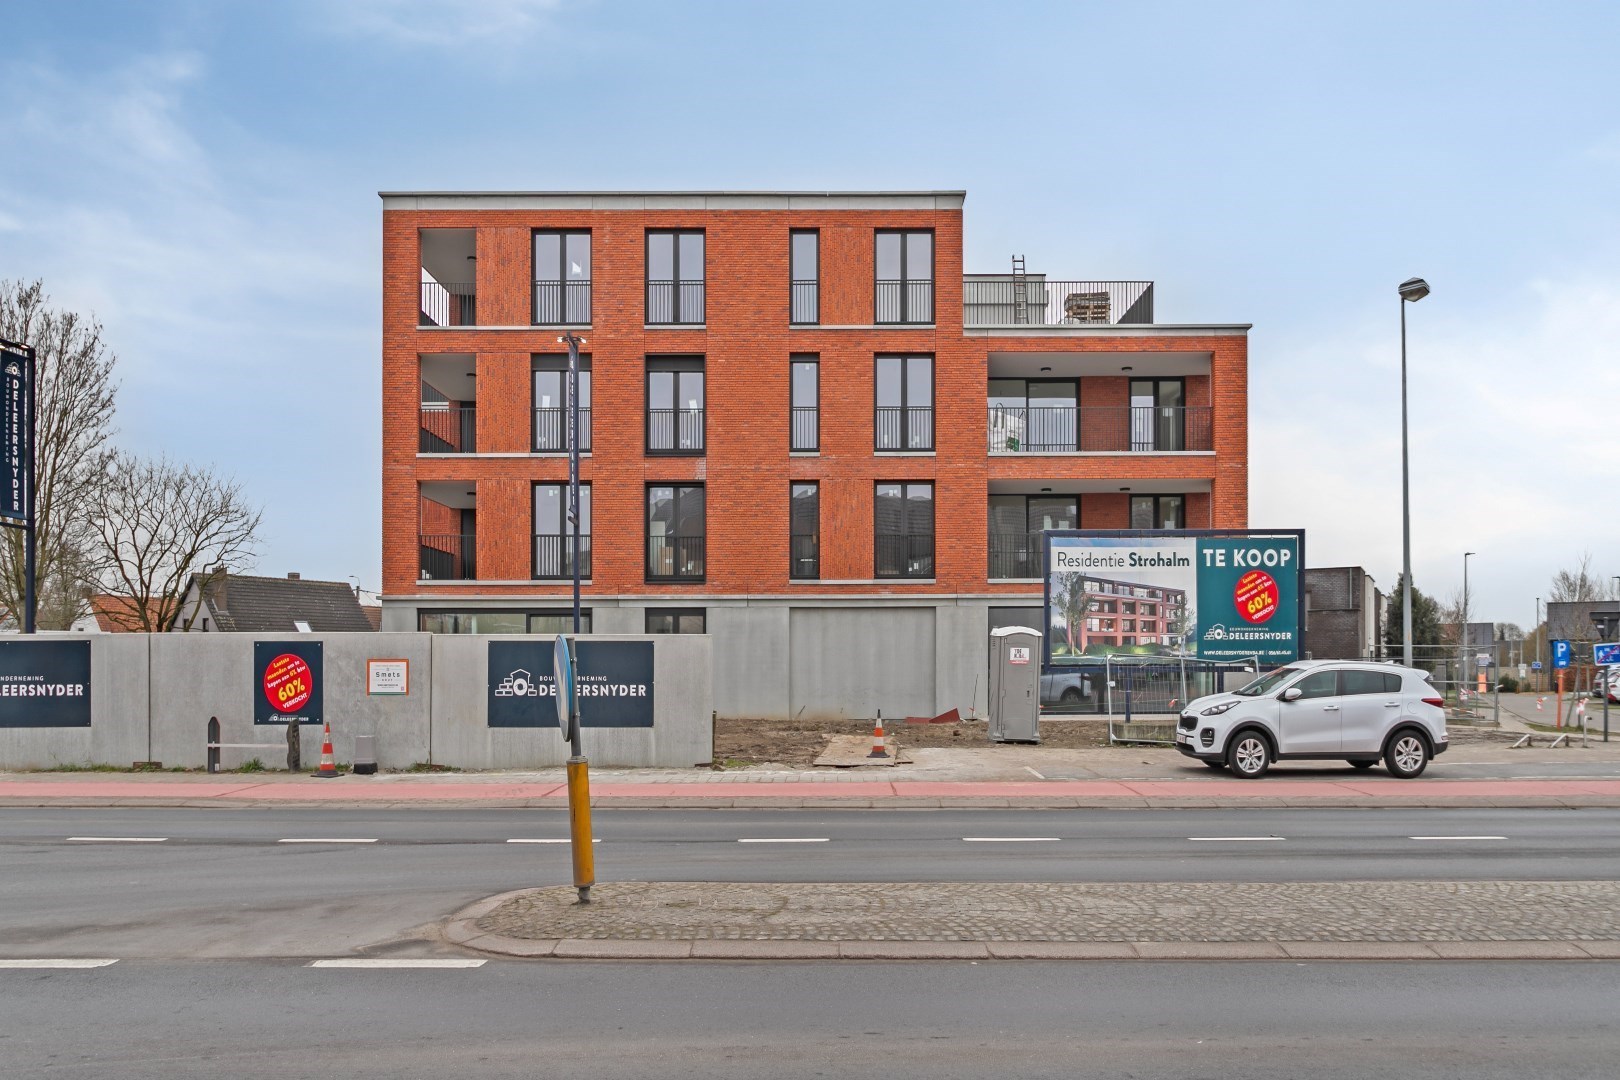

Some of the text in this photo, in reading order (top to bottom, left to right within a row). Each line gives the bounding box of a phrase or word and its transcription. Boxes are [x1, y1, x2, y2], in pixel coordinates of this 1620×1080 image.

[1057, 551, 1190, 567] Residentie Strohalm
[1202, 549, 1291, 567] TE KOOP
[1247, 590, 1273, 614] 60%
[1251, 604, 1274, 620] VERKOCHT
[1229, 632, 1292, 640] DELEERSNYDER
[1557, 642, 1567, 658] P
[0, 684, 84, 696] EERSNYDER
[278, 677, 306, 701] 60%
[539, 684, 647, 697] DEERSNYDER
[282, 692, 308, 709] VERKOCHT
